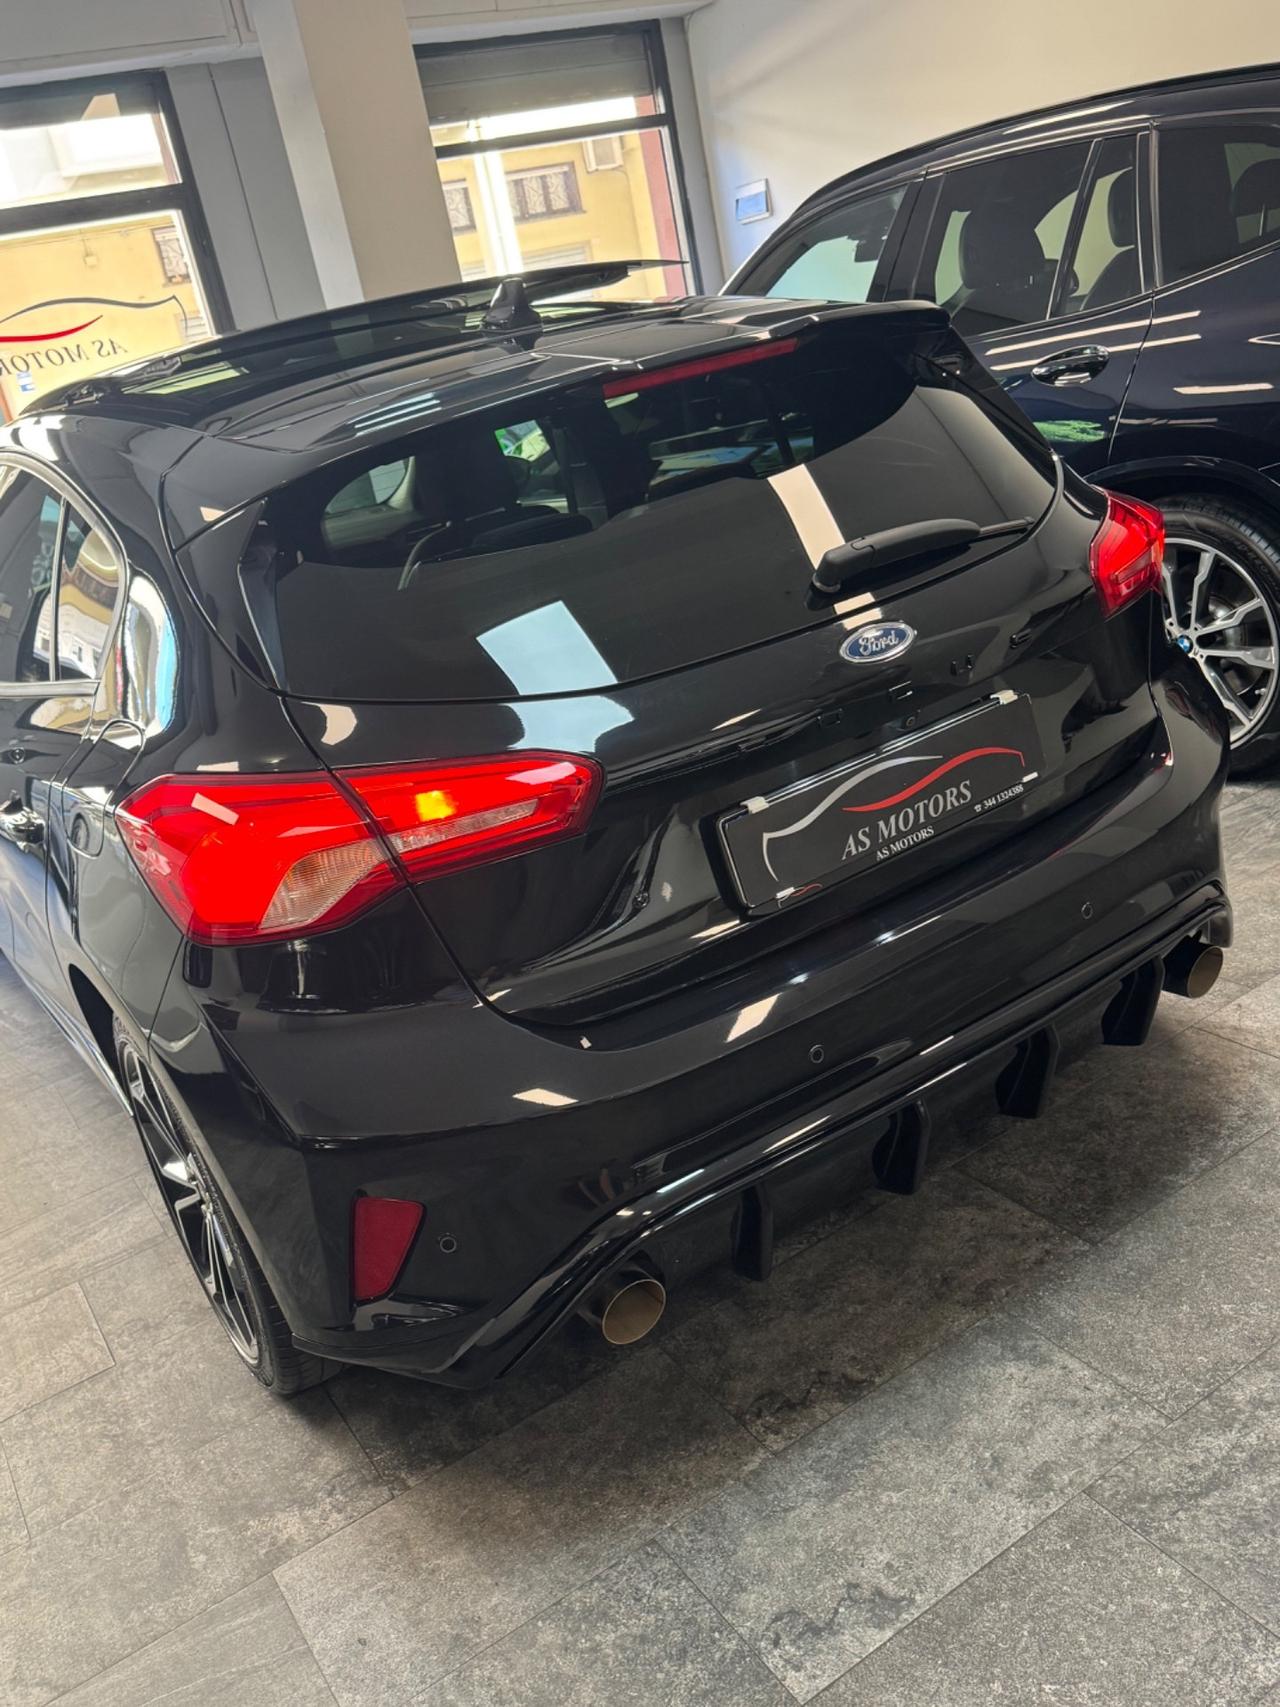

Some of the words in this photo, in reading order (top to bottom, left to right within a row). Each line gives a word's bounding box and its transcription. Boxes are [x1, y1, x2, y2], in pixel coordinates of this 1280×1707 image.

[859, 630, 899, 656] Ford
[983, 797, 997, 809] 344
[842, 827, 871, 861] AS
[878, 780, 972, 843] MOTORS
[876, 847, 890, 861] AS
[889, 825, 935, 856] MOTORS
